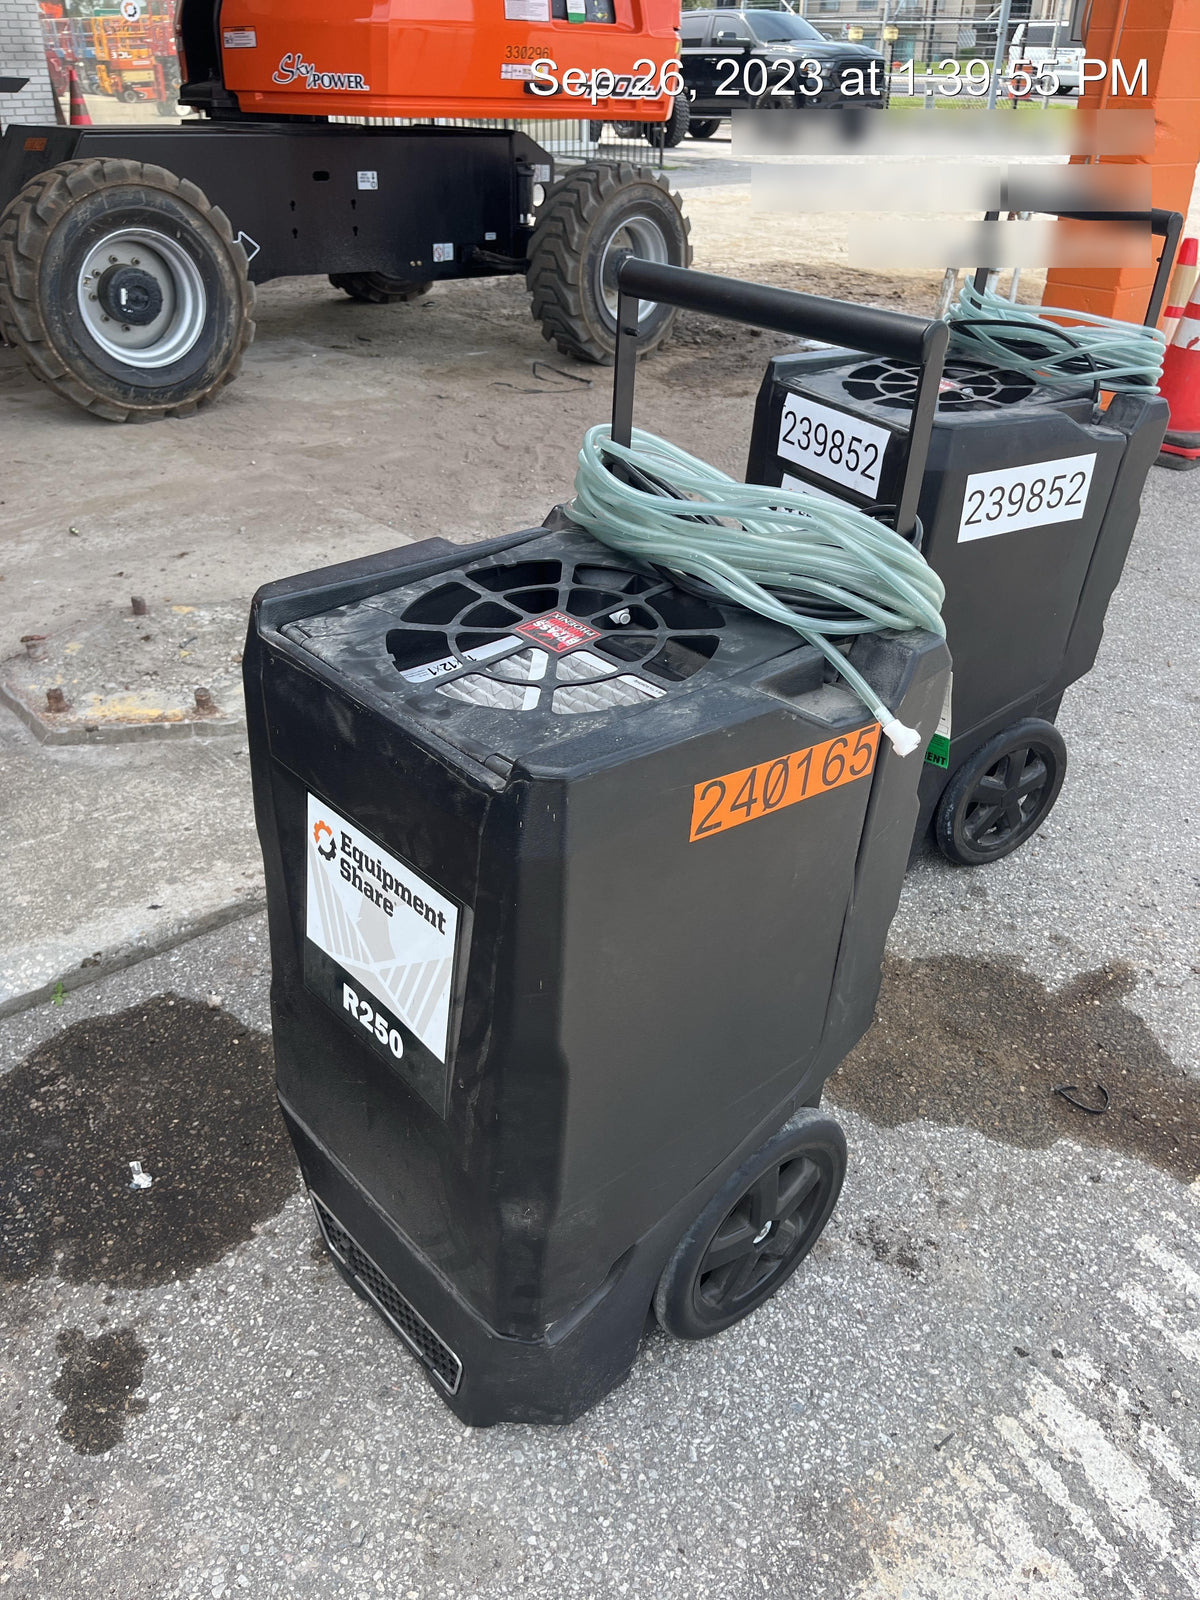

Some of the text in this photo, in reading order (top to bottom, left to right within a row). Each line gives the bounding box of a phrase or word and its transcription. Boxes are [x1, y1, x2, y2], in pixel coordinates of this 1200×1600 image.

[505, 45, 549, 59] 330296
[312, 73, 364, 90] POWER
[782, 410, 879, 481] 239852
[964, 471, 1086, 525] 239852
[533, 619, 583, 647] BYPASS
[553, 613, 597, 637] PHOENIX
[694, 725, 877, 837] 240165
[925, 751, 946, 766] ENT
[340, 830, 446, 936] Equipment
[340, 857, 395, 918] Share
[343, 982, 404, 1059] R250
